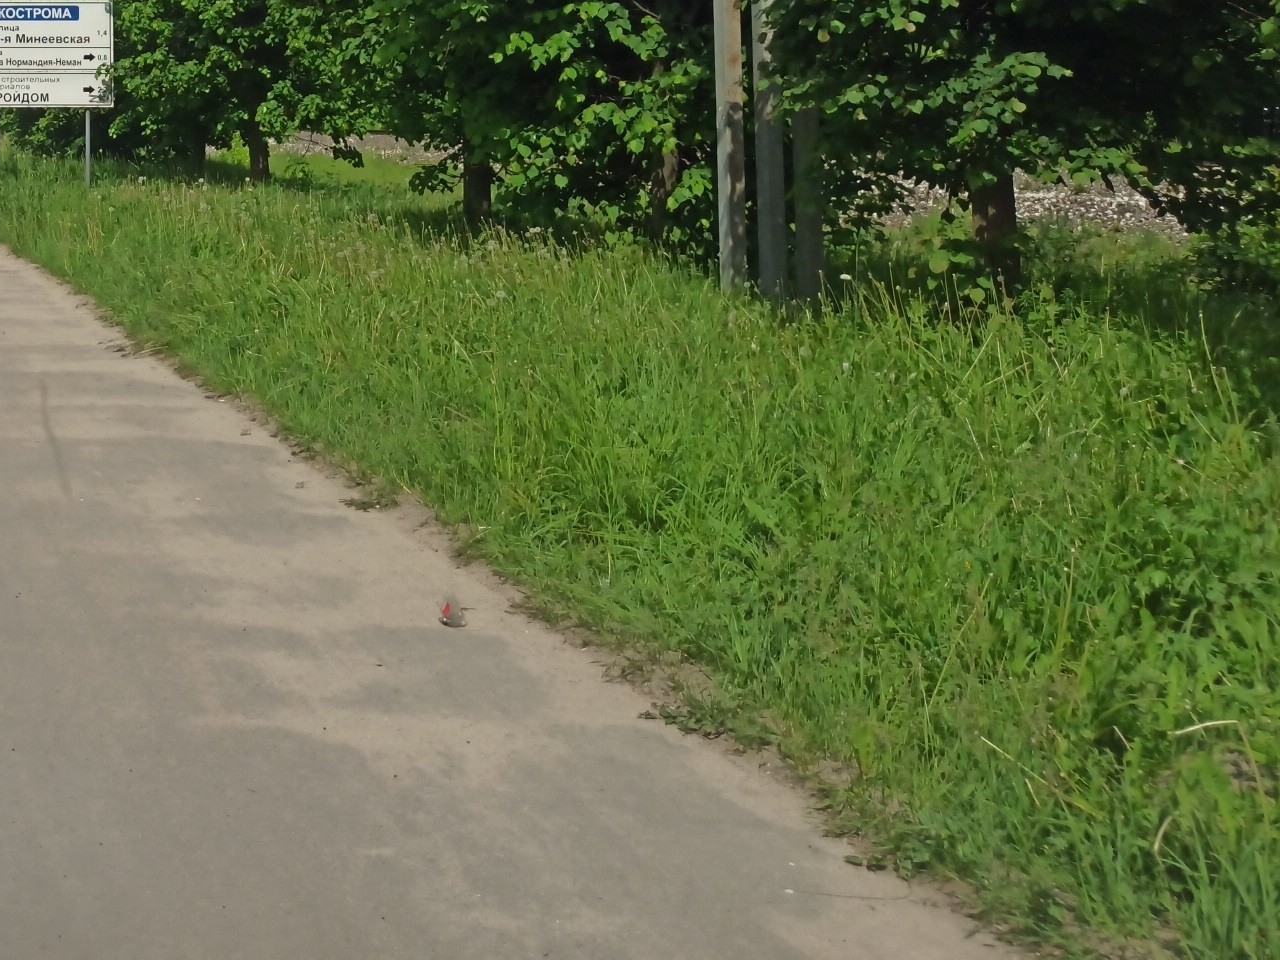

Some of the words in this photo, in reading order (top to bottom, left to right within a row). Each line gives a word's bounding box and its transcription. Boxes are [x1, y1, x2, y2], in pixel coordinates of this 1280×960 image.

[15, 34, 91, 44] Минеевская
[5, 58, 82, 67] Нормандия-Неман
[1, 76, 60, 84] строительных
